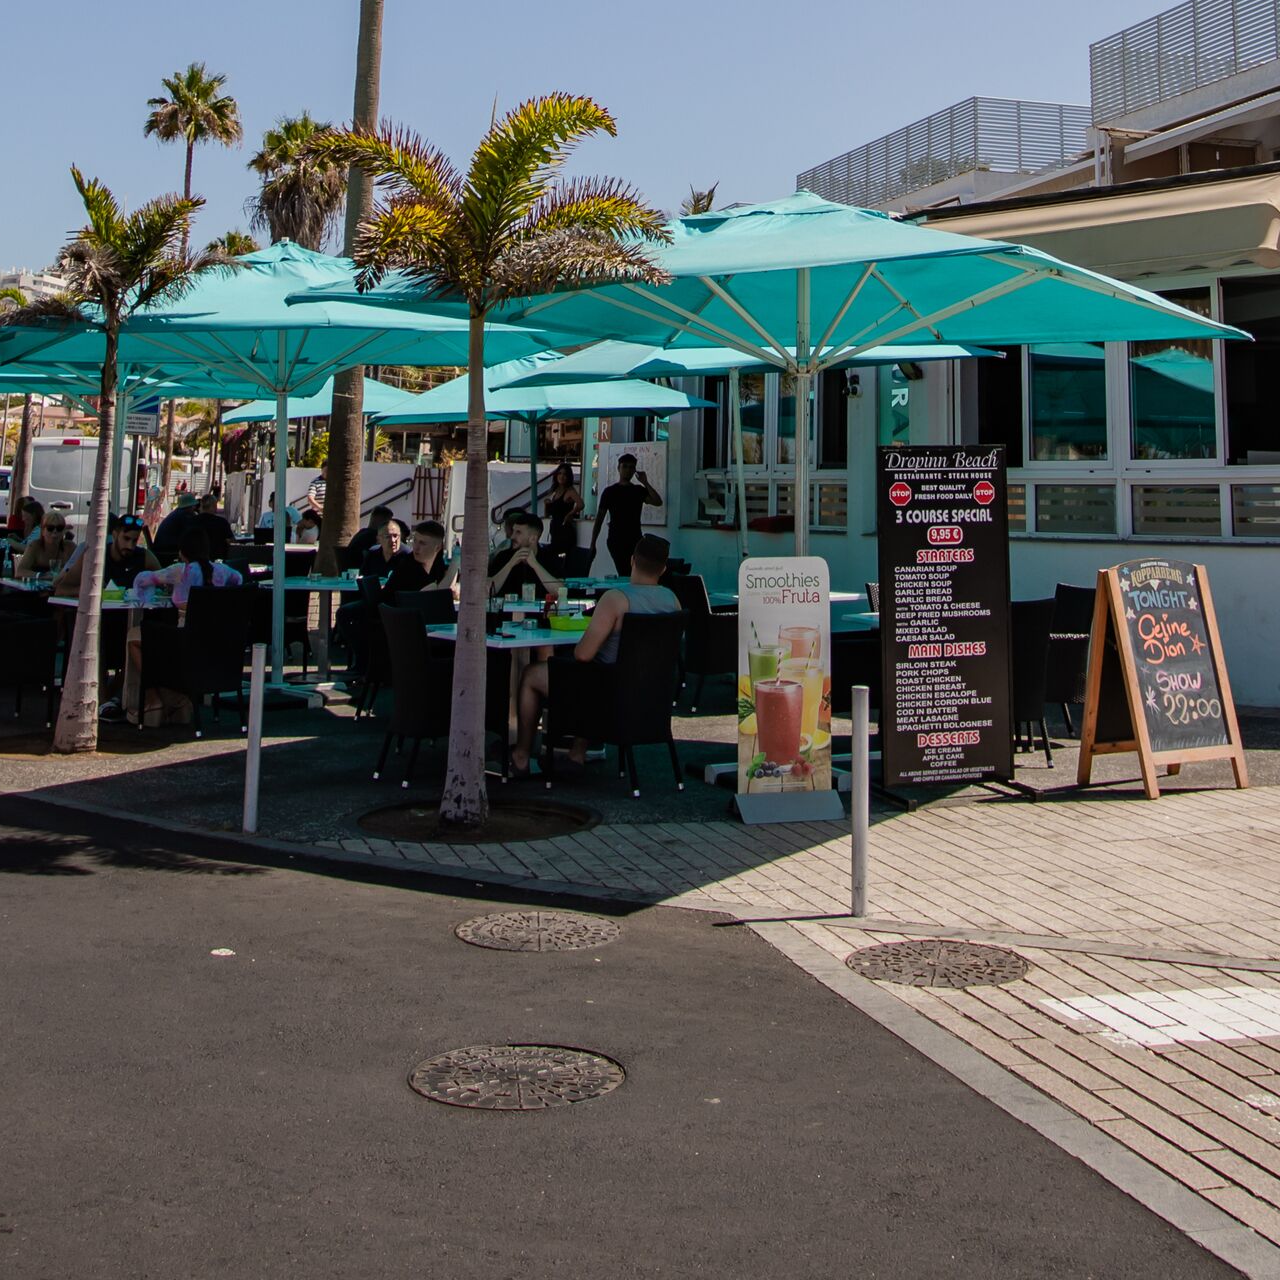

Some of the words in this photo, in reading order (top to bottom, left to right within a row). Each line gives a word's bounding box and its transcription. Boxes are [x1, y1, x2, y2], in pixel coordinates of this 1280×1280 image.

[885, 452, 948, 472] Dropinn
[953, 448, 1000, 468] Beach
[896, 510, 902, 523] 3
[906, 509, 948, 523] COURSE
[952, 509, 992, 522] SPECIAL
[932, 529, 950, 541] 9,95
[953, 529, 959, 539] €
[917, 548, 974, 563] STARTERS
[746, 573, 820, 589] Smoothies
[1131, 567, 1183, 587] KOPPARBERG
[763, 596, 781, 604] 100%
[782, 588, 820, 603] Fruta
[1128, 590, 1187, 611] TONIGHT
[1138, 613, 1191, 642] Celine
[908, 644, 942, 658] MAIN
[944, 641, 986, 656] DISHES
[1144, 640, 1185, 664] Dion
[896, 662, 928, 670] SIRLOIN
[1156, 672, 1201, 692] SHOW
[934, 690, 976, 698] ESCALOPE
[934, 698, 969, 706] CORDON
[1164, 693, 1220, 725] 22:00
[897, 723, 941, 732] SPAGHETTI
[944, 720, 992, 728] BOLOGNESE
[921, 714, 959, 722] LASAGNE
[918, 730, 980, 748] DESSERTS
